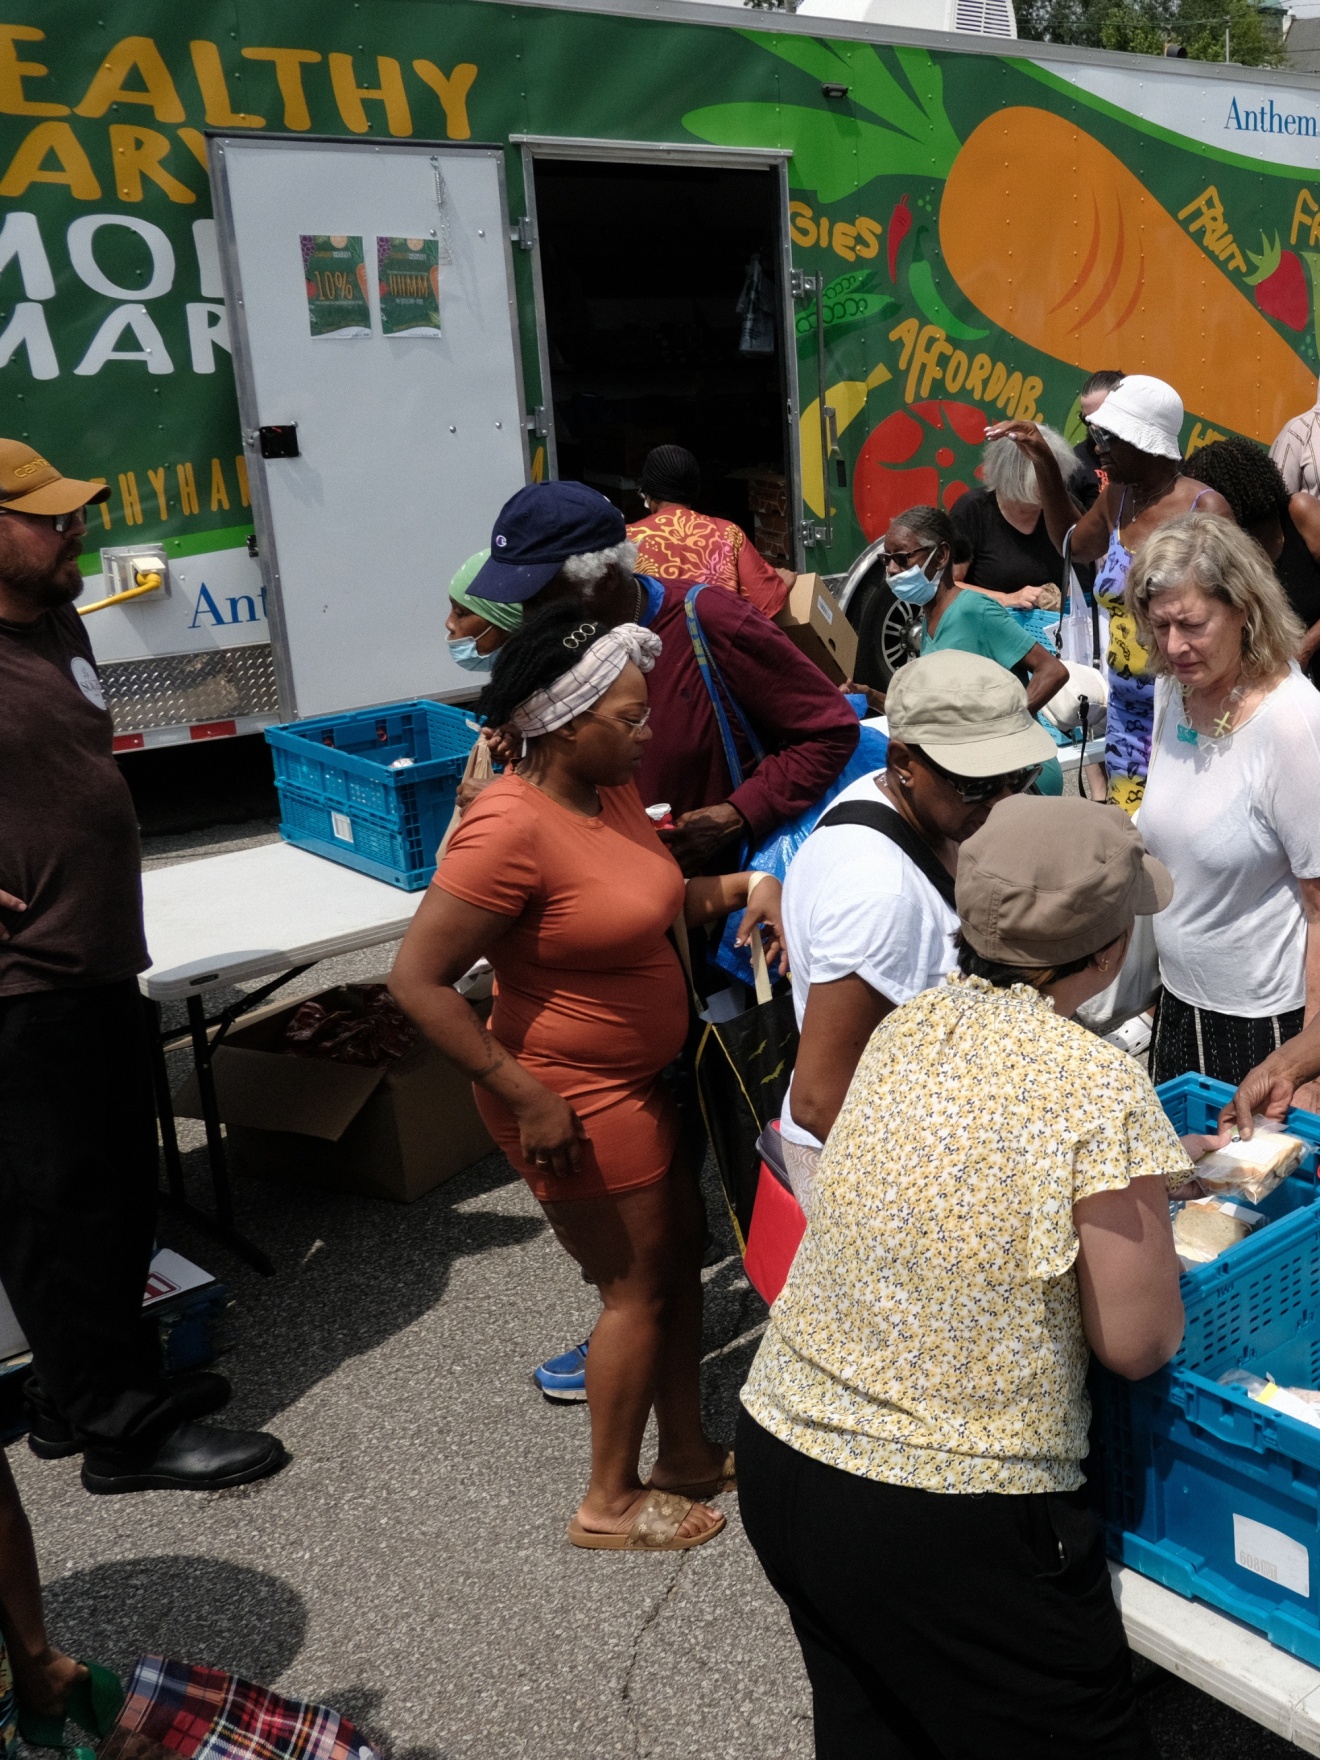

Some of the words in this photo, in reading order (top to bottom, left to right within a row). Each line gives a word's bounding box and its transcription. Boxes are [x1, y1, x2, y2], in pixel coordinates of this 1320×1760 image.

[0, 23, 478, 139] EALTHY
[1223, 96, 1318, 137] Anthem
[790, 201, 882, 262] GIES
[1178, 185, 1247, 273] FRUIT
[314, 271, 353, 300] 10%
[888, 317, 1044, 424] AFFORDAB
